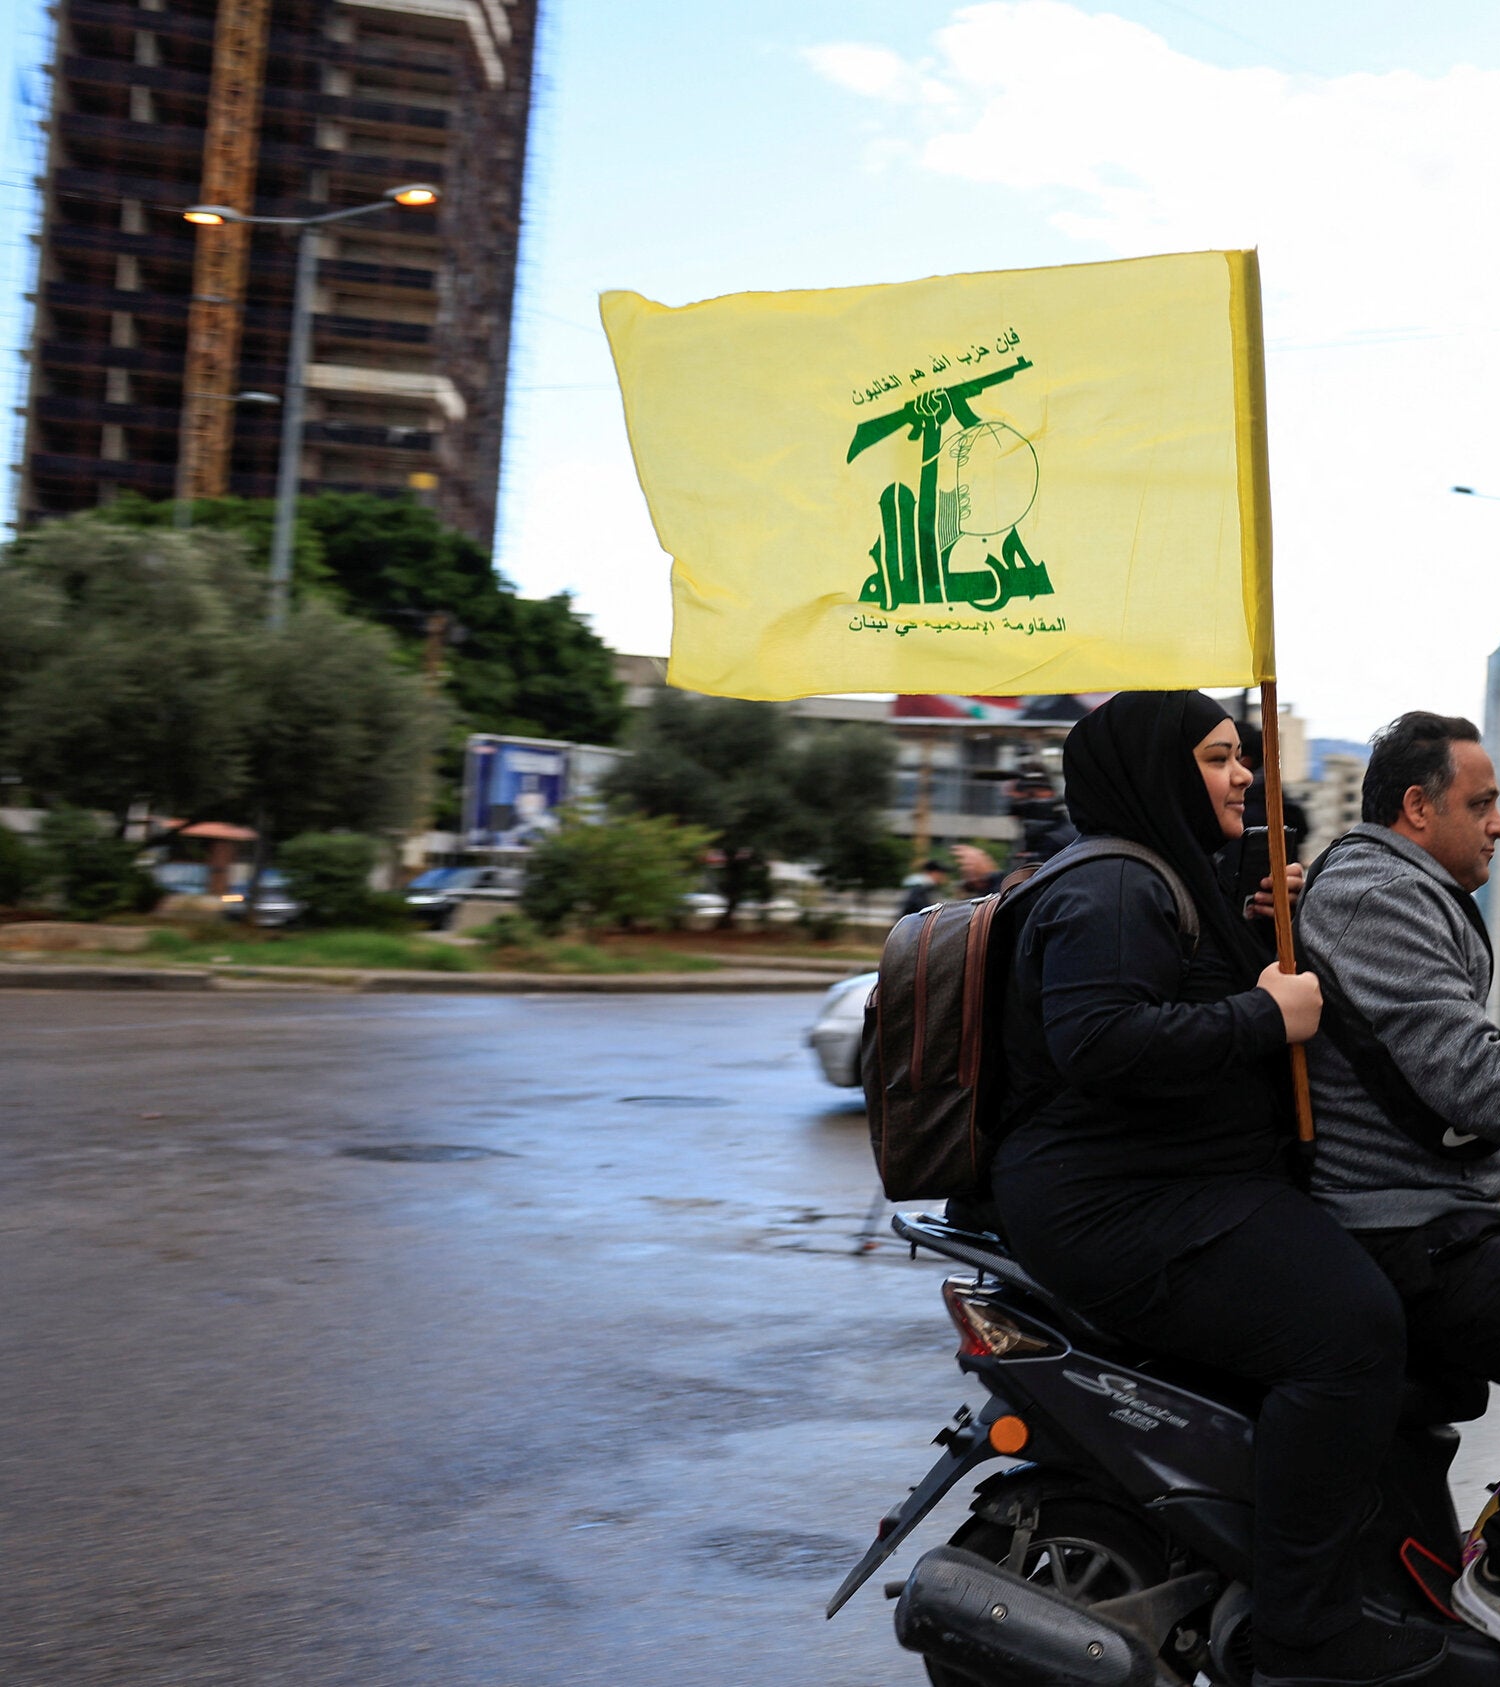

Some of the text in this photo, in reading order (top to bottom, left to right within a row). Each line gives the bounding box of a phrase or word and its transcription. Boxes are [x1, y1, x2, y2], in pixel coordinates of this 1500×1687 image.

[932, 353, 952, 374] الله
[956, 344, 990, 365] حزب
[909, 367, 926, 387] هم
[851, 374, 903, 406] الغالبون
[1002, 616, 1066, 635] المقاومة
